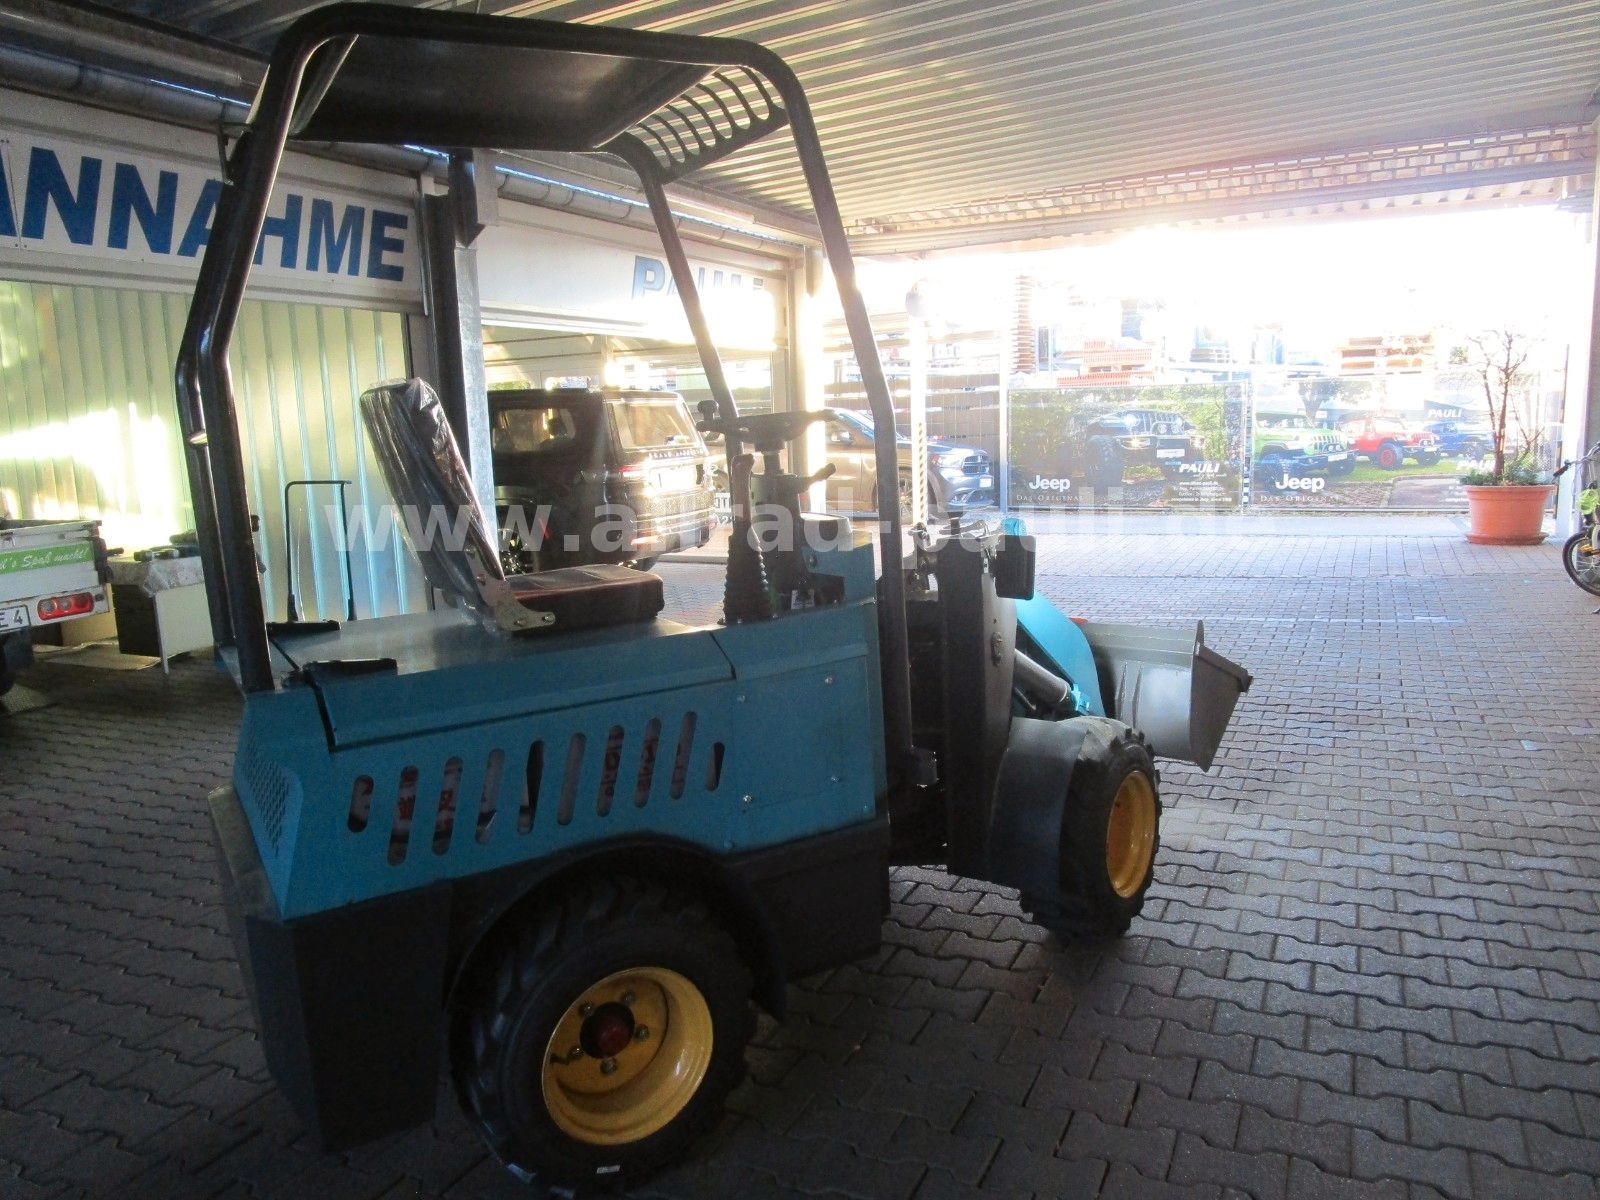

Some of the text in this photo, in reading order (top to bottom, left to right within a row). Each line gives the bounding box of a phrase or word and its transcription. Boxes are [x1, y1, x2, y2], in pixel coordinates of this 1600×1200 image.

[1179, 463, 1220, 473] PAULI
[1028, 474, 1071, 493] Jeep
[1275, 473, 1325, 493] Jeep
